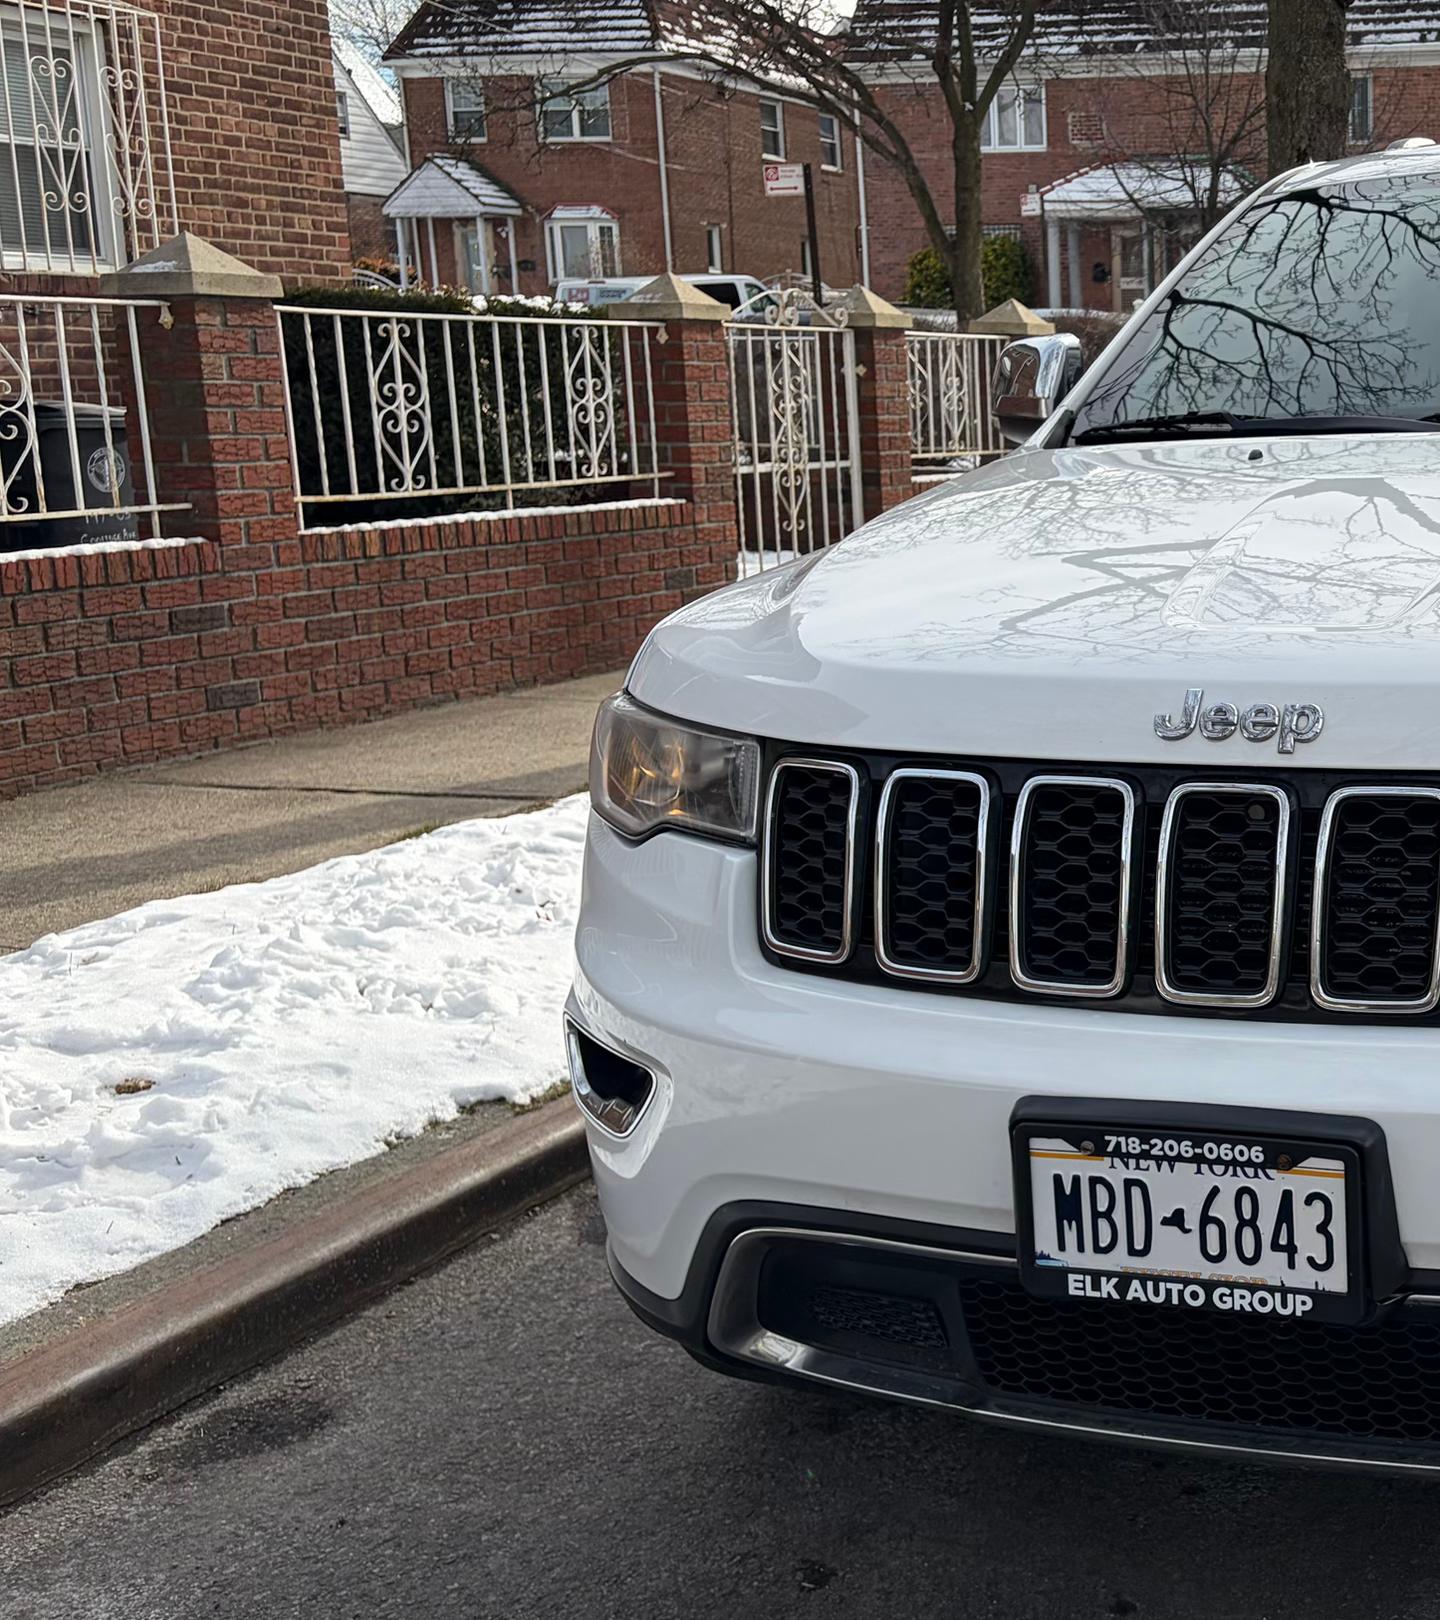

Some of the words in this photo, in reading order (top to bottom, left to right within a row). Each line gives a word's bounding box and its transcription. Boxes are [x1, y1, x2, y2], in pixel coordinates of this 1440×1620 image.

[1153, 688, 1325, 754] Jeep
[1104, 1135, 1265, 1164] 718-206-0606
[1052, 1172, 1154, 1258] MBD
[1199, 1184, 1335, 1273] 6843
[1067, 1273, 1121, 1300] ELK
[1125, 1278, 1206, 1308] AUTO
[1212, 1288, 1314, 1317] GROUP
